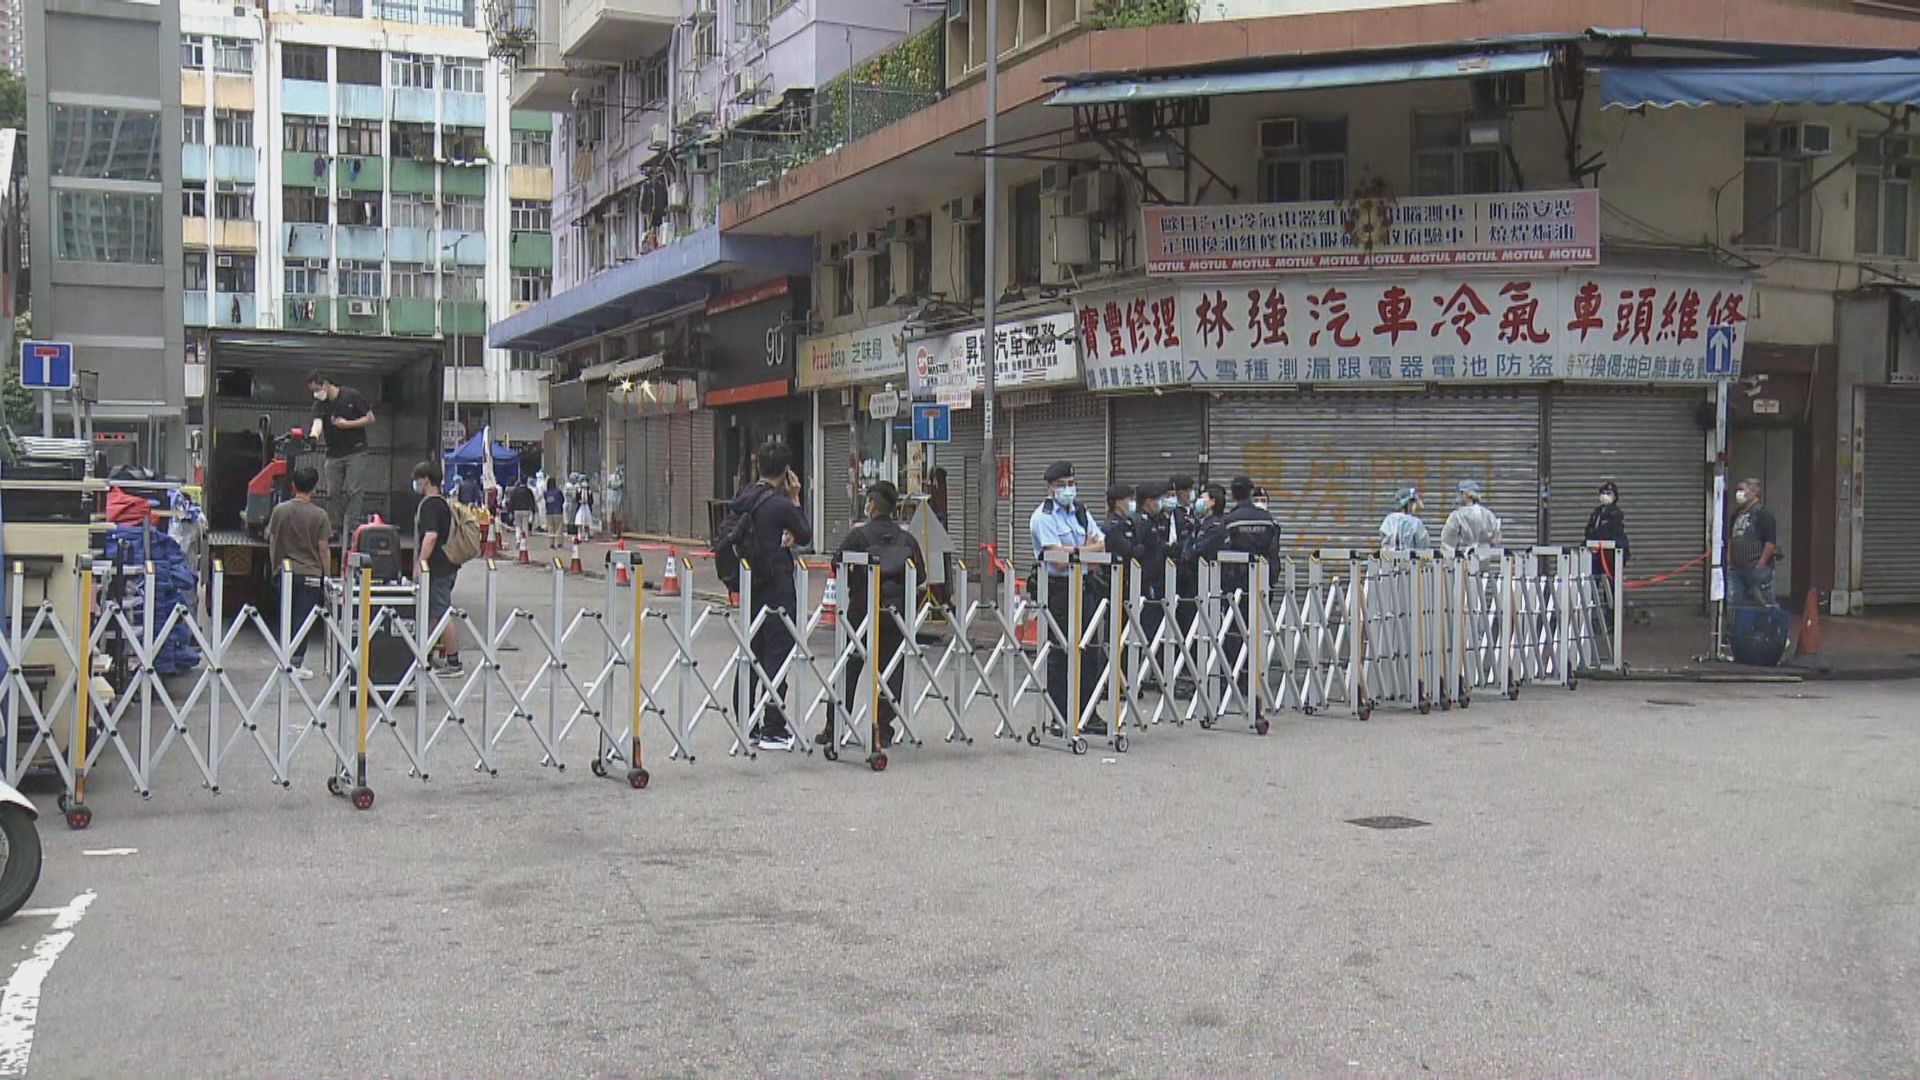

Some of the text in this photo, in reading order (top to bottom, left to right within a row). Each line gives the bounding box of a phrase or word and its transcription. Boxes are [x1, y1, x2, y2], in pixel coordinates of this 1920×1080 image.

[1149, 261, 1185, 272] MOTUL
[1189, 259, 1229, 271] MOTUL
[1232, 258, 1271, 270] MOTUL
[1275, 257, 1315, 268] MOTUL
[1319, 255, 1360, 267] MOTUL
[1409, 252, 1451, 263] MOTUL
[1455, 251, 1498, 262] MOTUL
[1502, 249, 1545, 260] MOTUL
[1549, 248, 1593, 259] MOTUL
